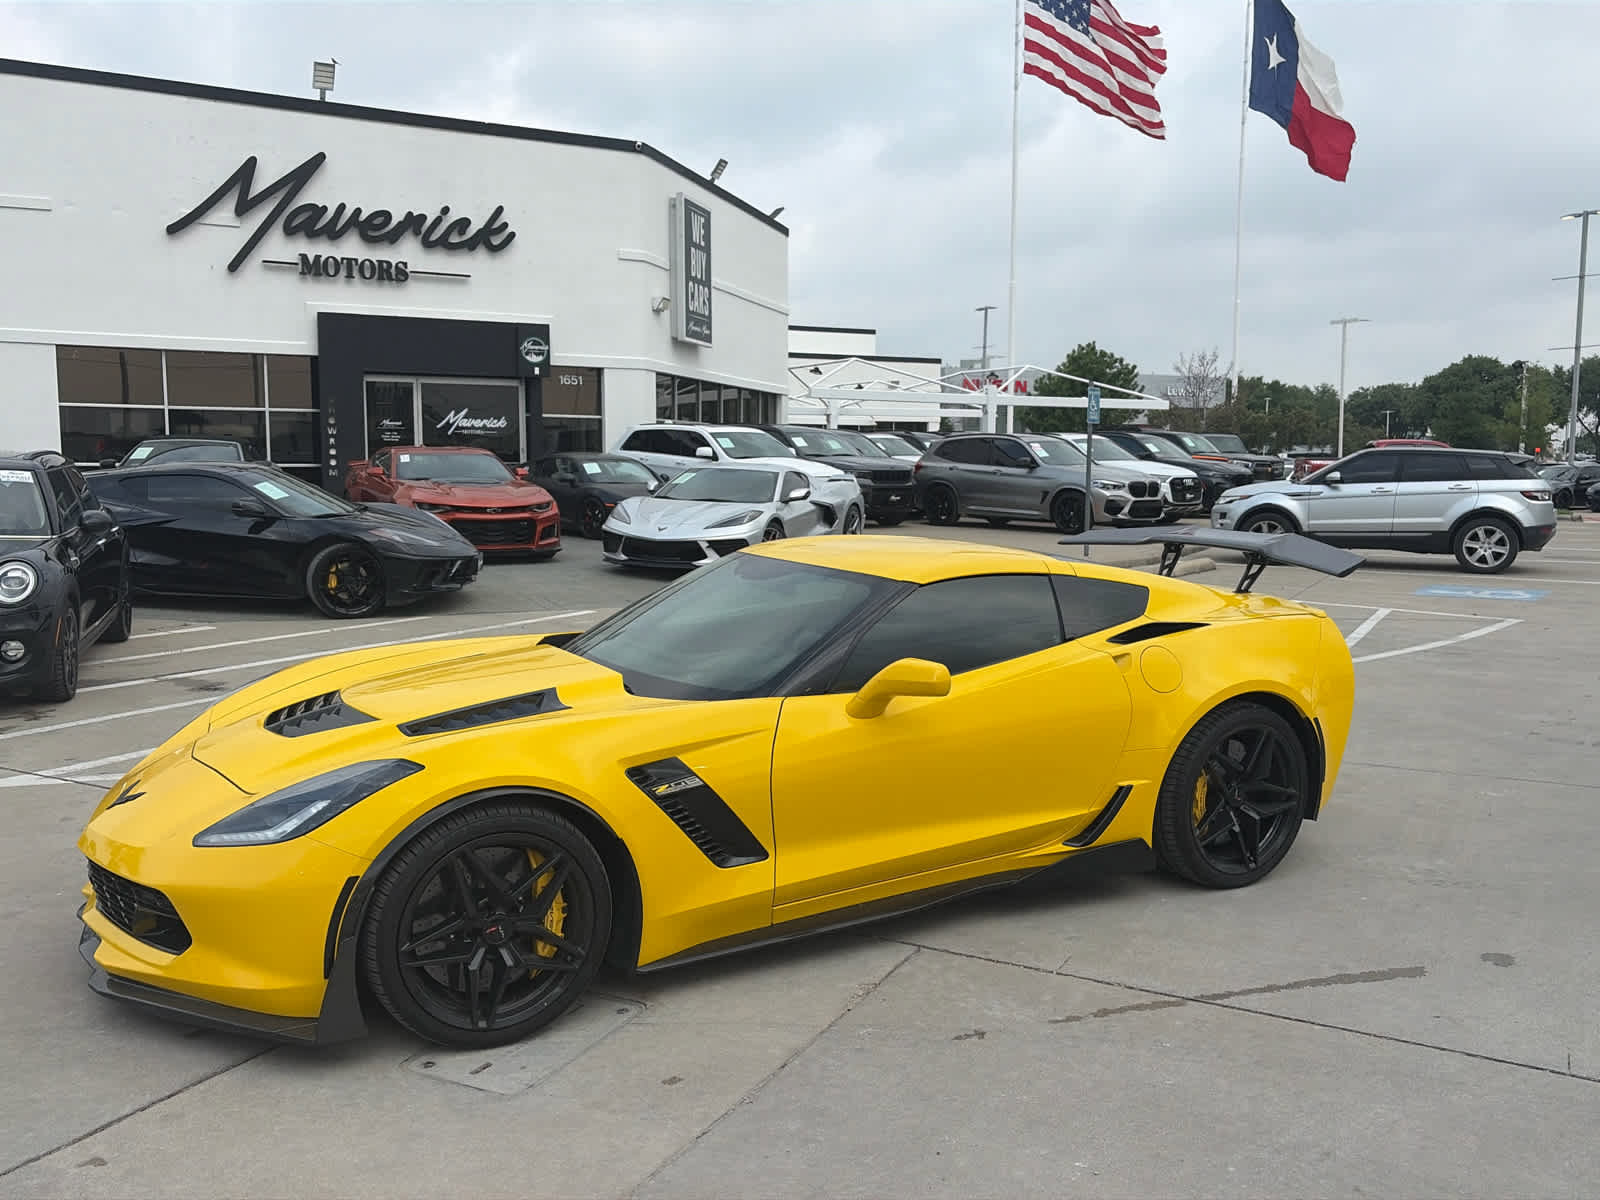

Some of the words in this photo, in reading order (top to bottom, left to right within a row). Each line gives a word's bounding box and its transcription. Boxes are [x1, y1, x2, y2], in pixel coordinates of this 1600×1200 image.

[166, 152, 516, 272] Maverick
[691, 211, 705, 246] WE
[298, 253, 410, 282] MOTORS
[690, 247, 707, 281] BUY
[688, 281, 709, 316] CARS
[560, 375, 583, 385] 1651
[436, 408, 508, 435] Maverick
